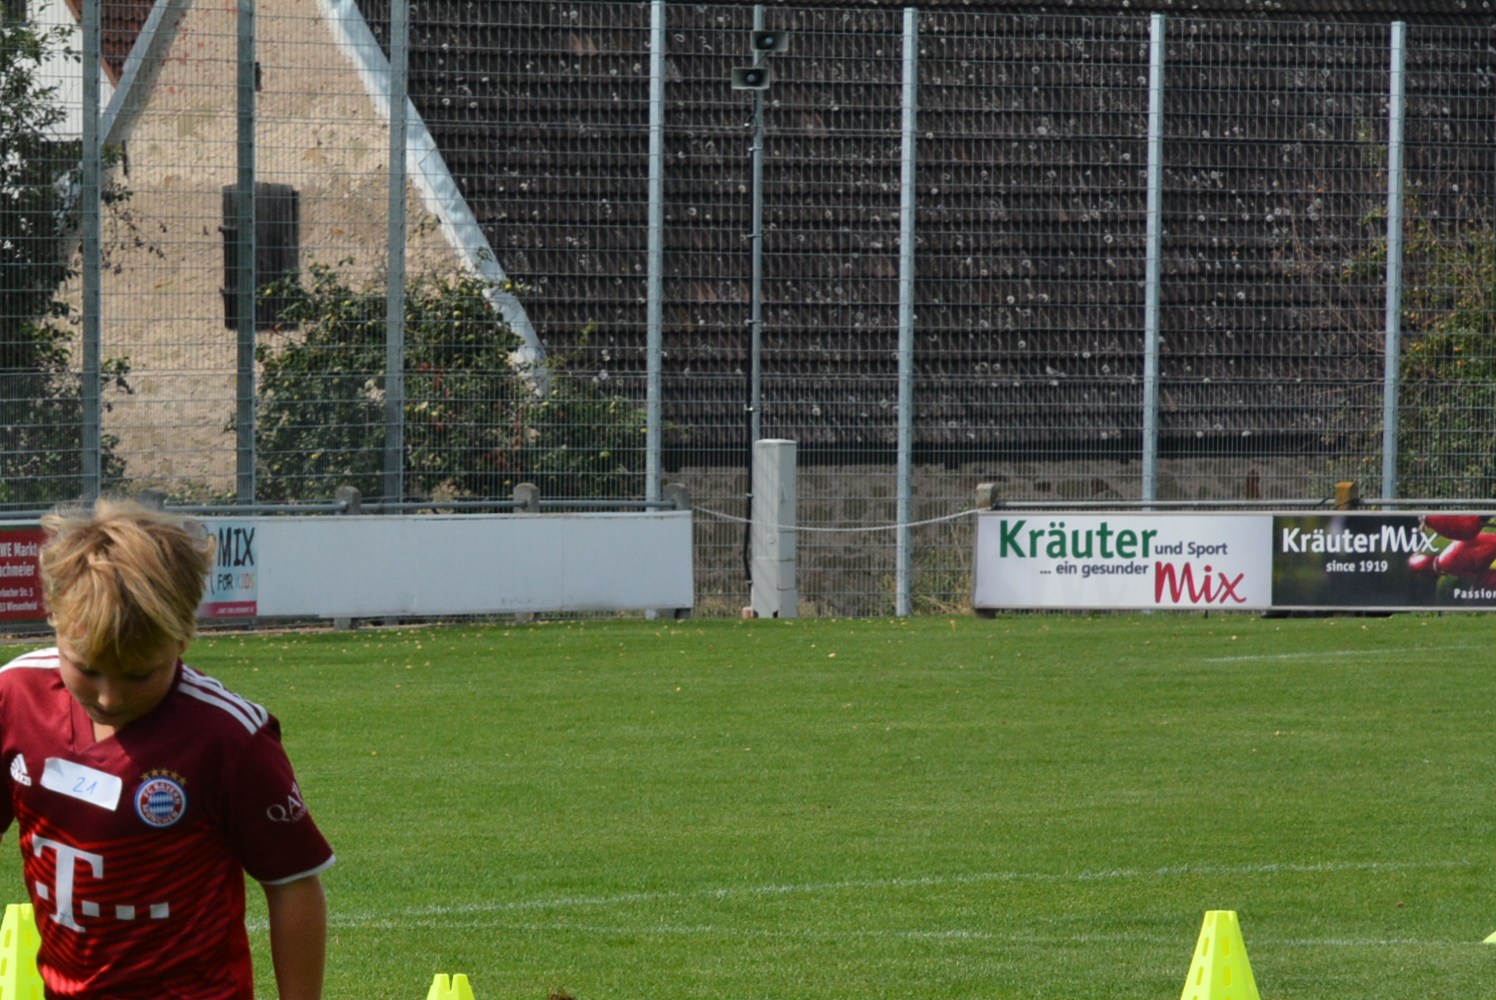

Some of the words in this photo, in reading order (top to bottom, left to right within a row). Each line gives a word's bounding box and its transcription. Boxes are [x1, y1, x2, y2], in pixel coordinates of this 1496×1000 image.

[217, 527, 255, 567] MIX
[999, 520, 1158, 559] Kräuter
[1155, 541, 1183, 555] und
[1187, 542, 1228, 558] Sport
[1282, 524, 1439, 554] KräuterMix
[14, 541, 37, 556] Markt
[1056, 562, 1077, 574] ein
[1081, 561, 1149, 578] gesunder
[1326, 560, 1355, 573] since
[1359, 560, 1388, 572] 1919
[218, 573, 233, 590] FOR
[1154, 561, 1247, 604] Mix
[73, 777, 98, 795] 21
